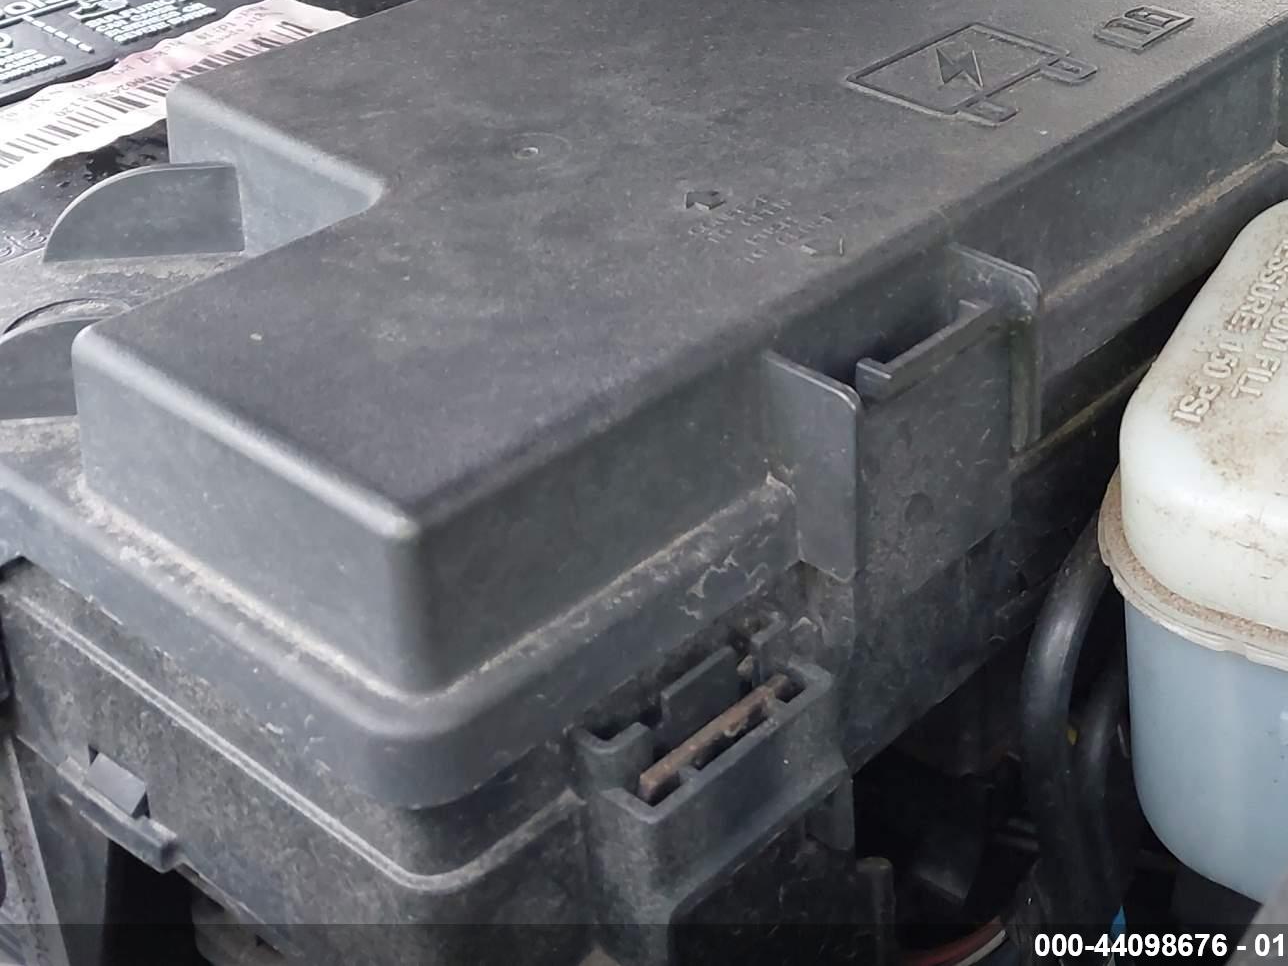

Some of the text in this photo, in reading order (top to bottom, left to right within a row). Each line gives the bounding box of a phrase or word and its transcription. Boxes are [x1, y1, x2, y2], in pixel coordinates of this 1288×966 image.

[1202, 341, 1244, 378] 150
[1230, 354, 1280, 399] FILL
[1171, 378, 1217, 424] PSI
